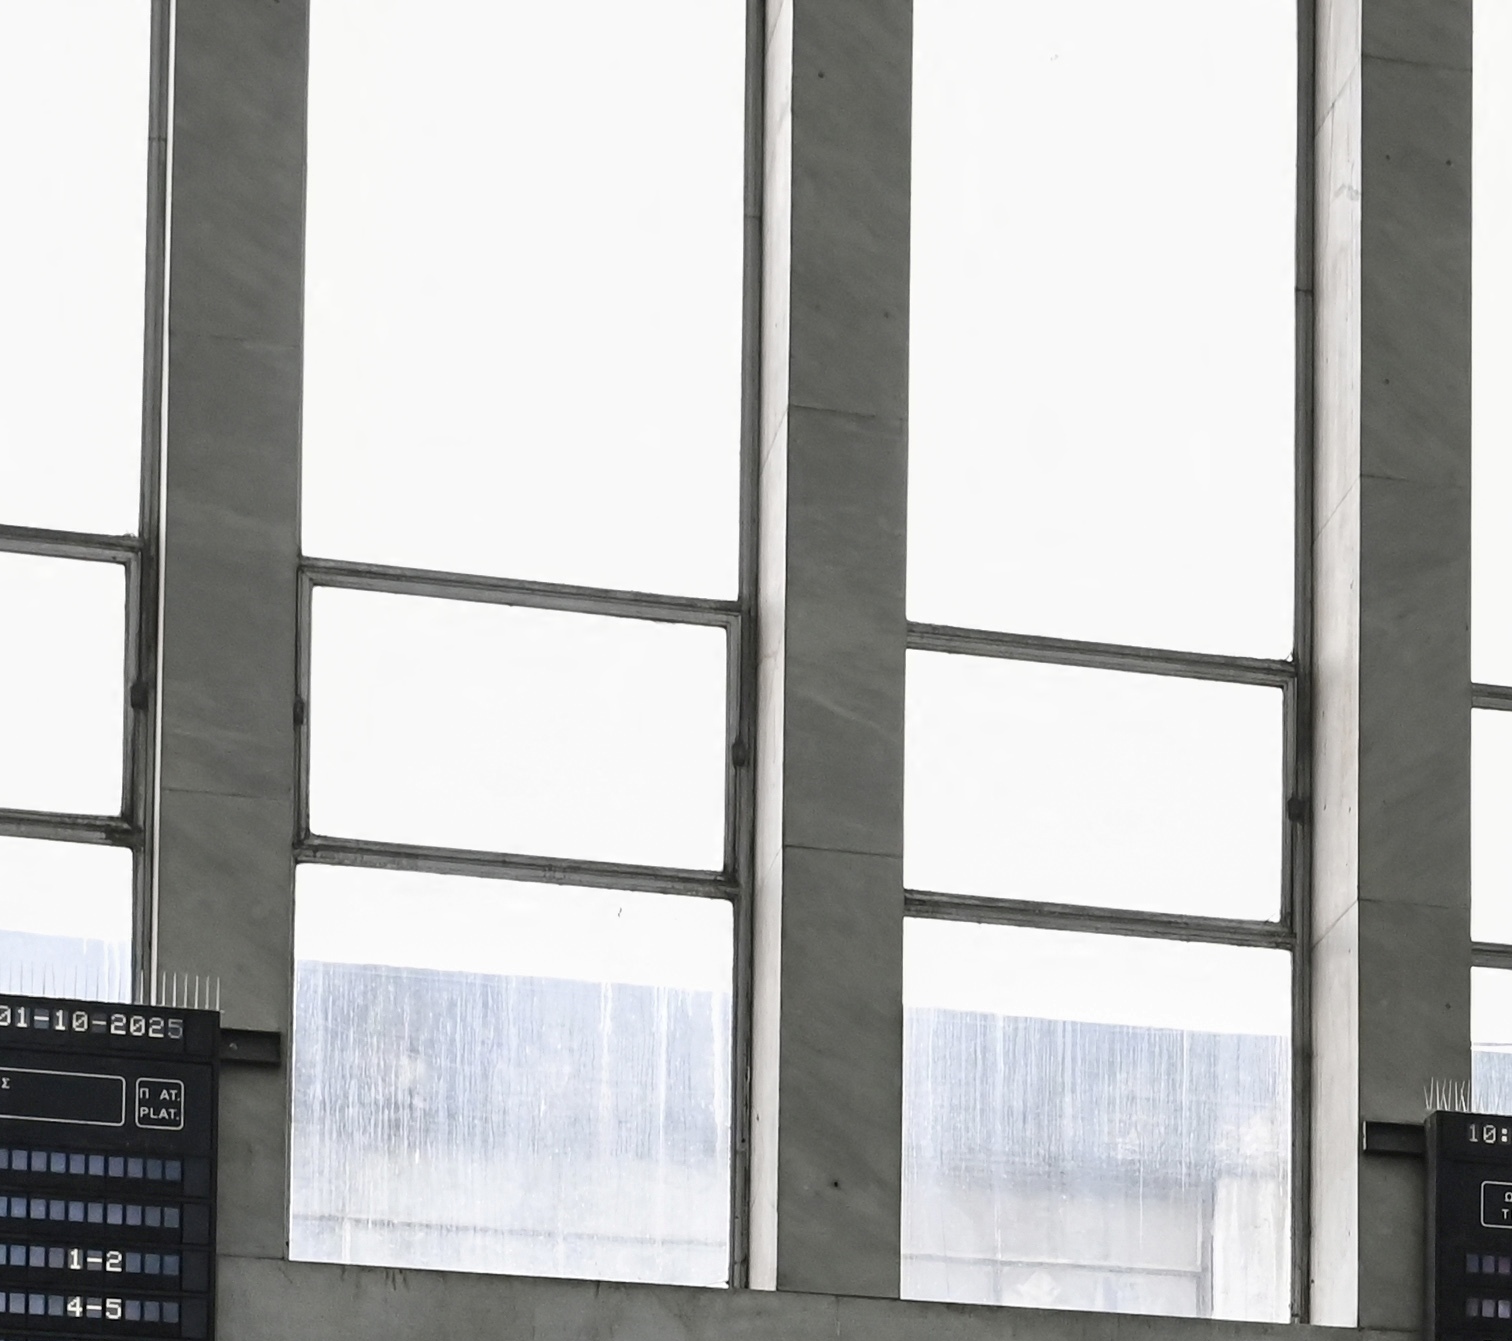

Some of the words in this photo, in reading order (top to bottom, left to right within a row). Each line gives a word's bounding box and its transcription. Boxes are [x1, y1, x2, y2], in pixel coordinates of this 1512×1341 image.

[139, 1106, 176, 1120] PLAT.
[69, 1248, 123, 1272] 1-2
[66, 1296, 122, 1320] 4-5
